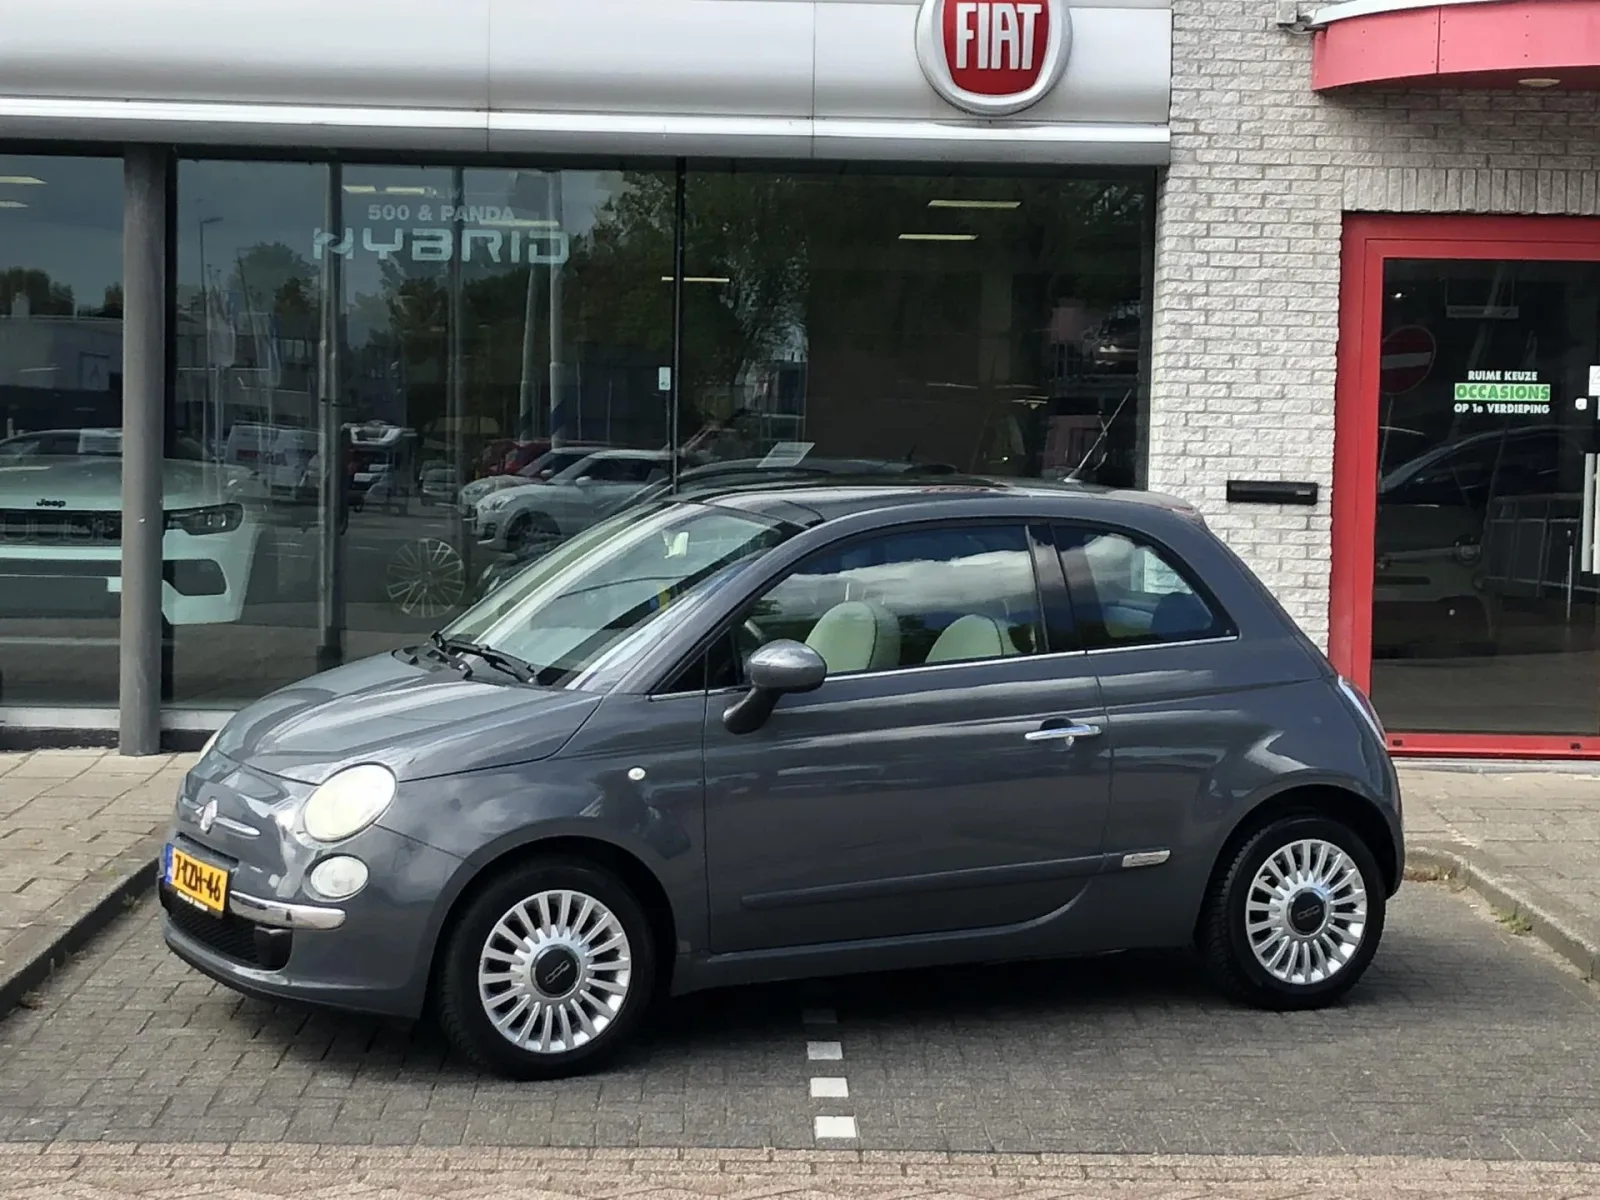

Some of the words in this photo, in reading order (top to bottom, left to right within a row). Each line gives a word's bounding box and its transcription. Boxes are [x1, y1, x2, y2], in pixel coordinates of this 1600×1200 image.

[956, 2, 1042, 70] FIAT
[368, 204, 410, 221] 500
[417, 205, 433, 221] &
[440, 205, 516, 224] PANDA
[312, 227, 569, 264] HYBRID
[1468, 371, 1501, 381] RUIME
[1504, 371, 1538, 381] KEUZE
[1456, 385, 1550, 400] OCCASIONS
[1454, 403, 1469, 413] OP
[1487, 403, 1550, 414] VERDIEPING
[36, 498, 66, 508] Jeep
